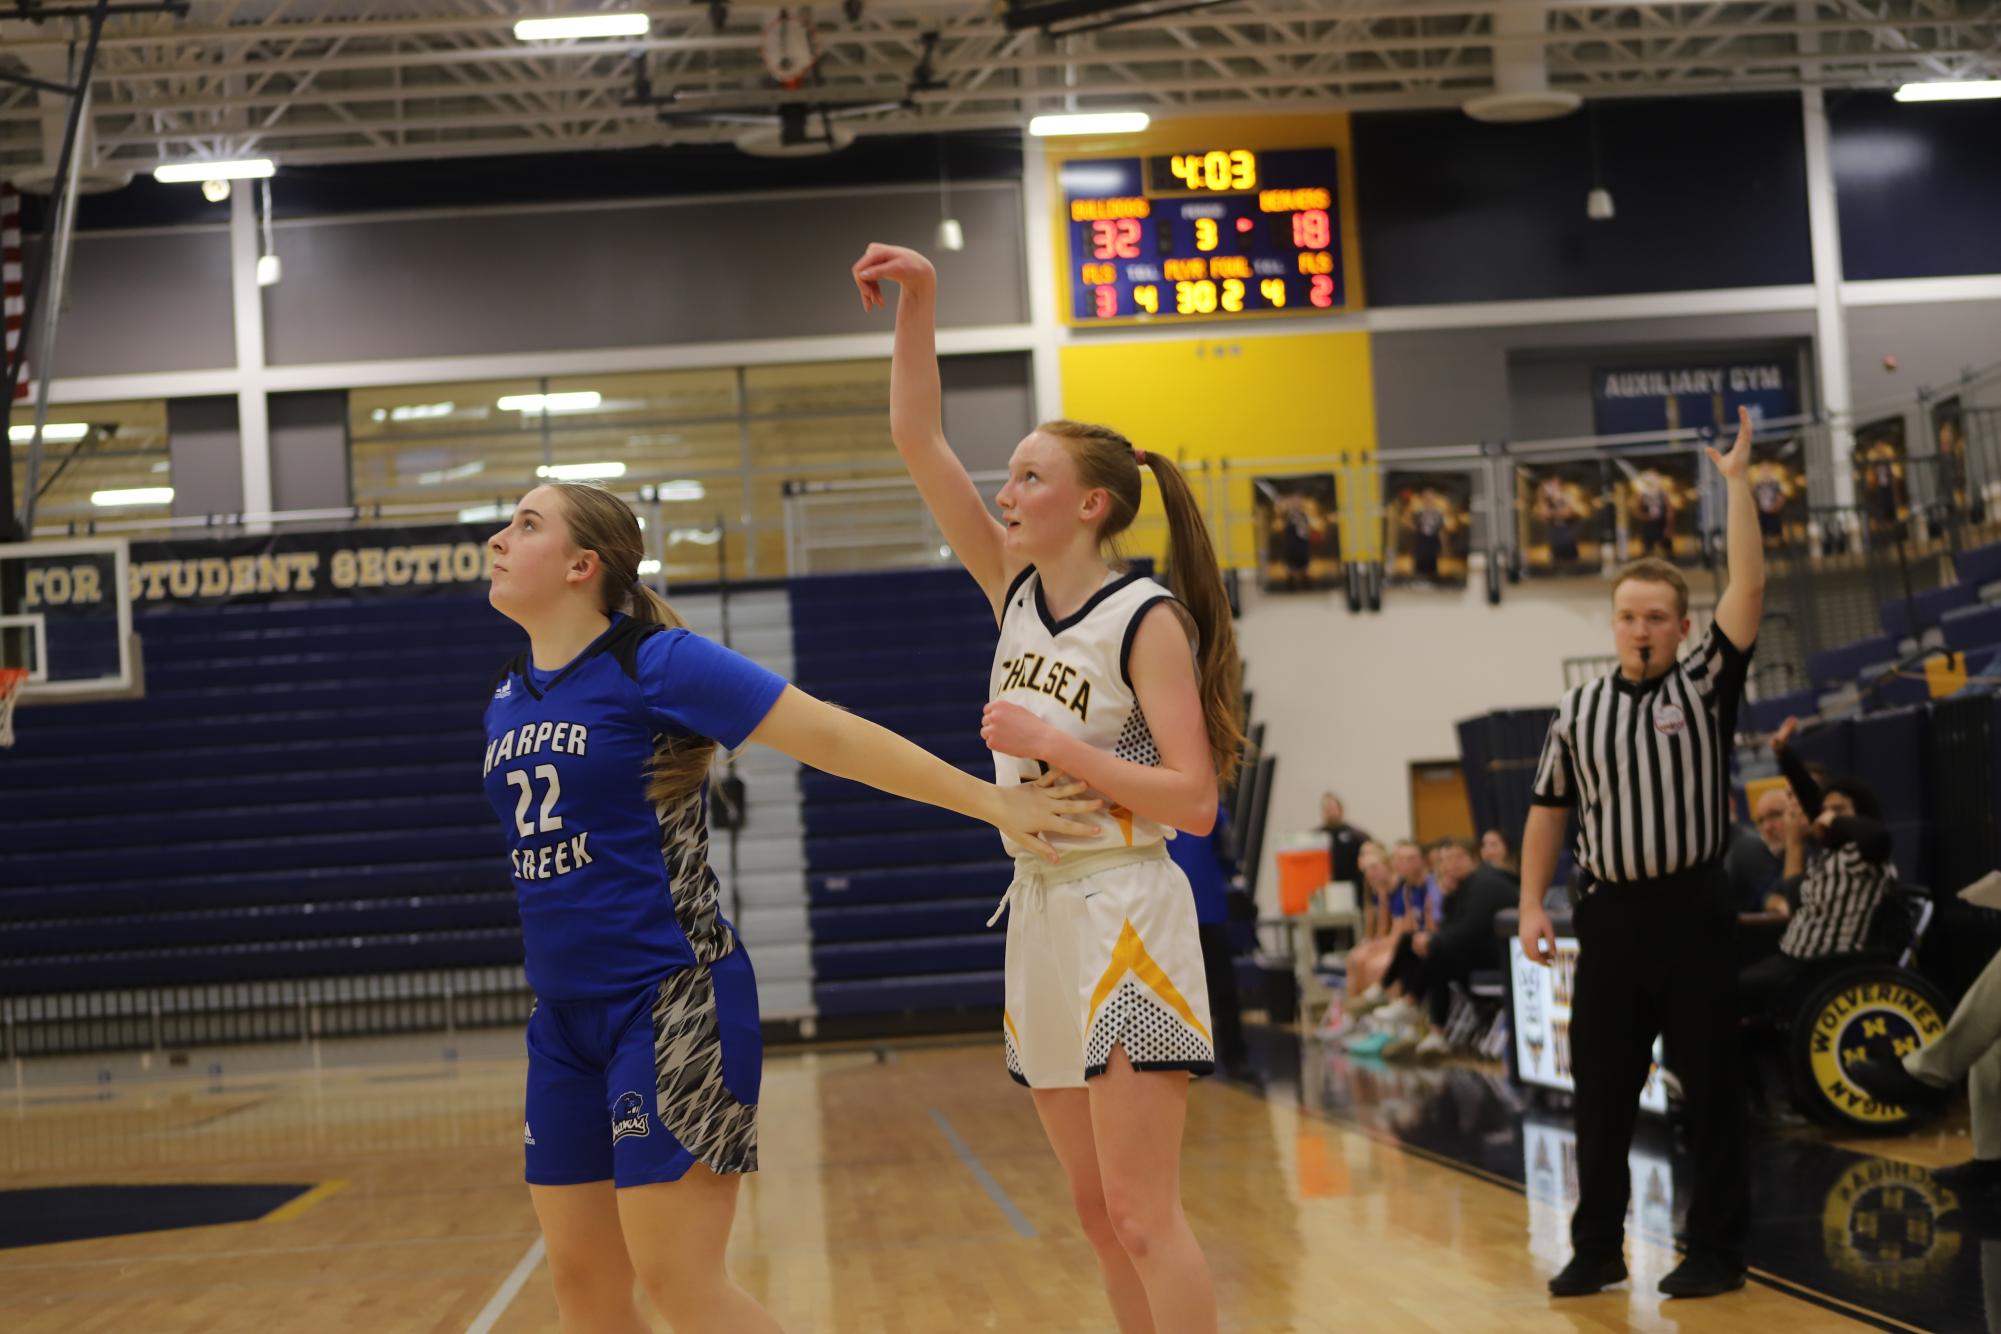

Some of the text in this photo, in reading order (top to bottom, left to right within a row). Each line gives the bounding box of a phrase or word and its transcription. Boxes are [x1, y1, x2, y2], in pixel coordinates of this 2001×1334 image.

[1171, 150, 1256, 190] 4:03
[1092, 219, 1142, 259] 32
[1196, 218, 1218, 251] 3
[1096, 285, 1118, 318] 3
[1134, 285, 1158, 313] 4
[1176, 280, 1217, 314] 30
[1221, 278, 1245, 312] 2
[1261, 279, 1285, 307] 4
[1311, 275, 1333, 307] 2
[1605, 365, 1782, 398] AUXILIARY GYM
[998, 652, 1091, 724] HELSEA
[483, 721, 587, 779] HARPER
[506, 763, 563, 838] 22
[1812, 984, 1941, 1054] WOLVERINES
